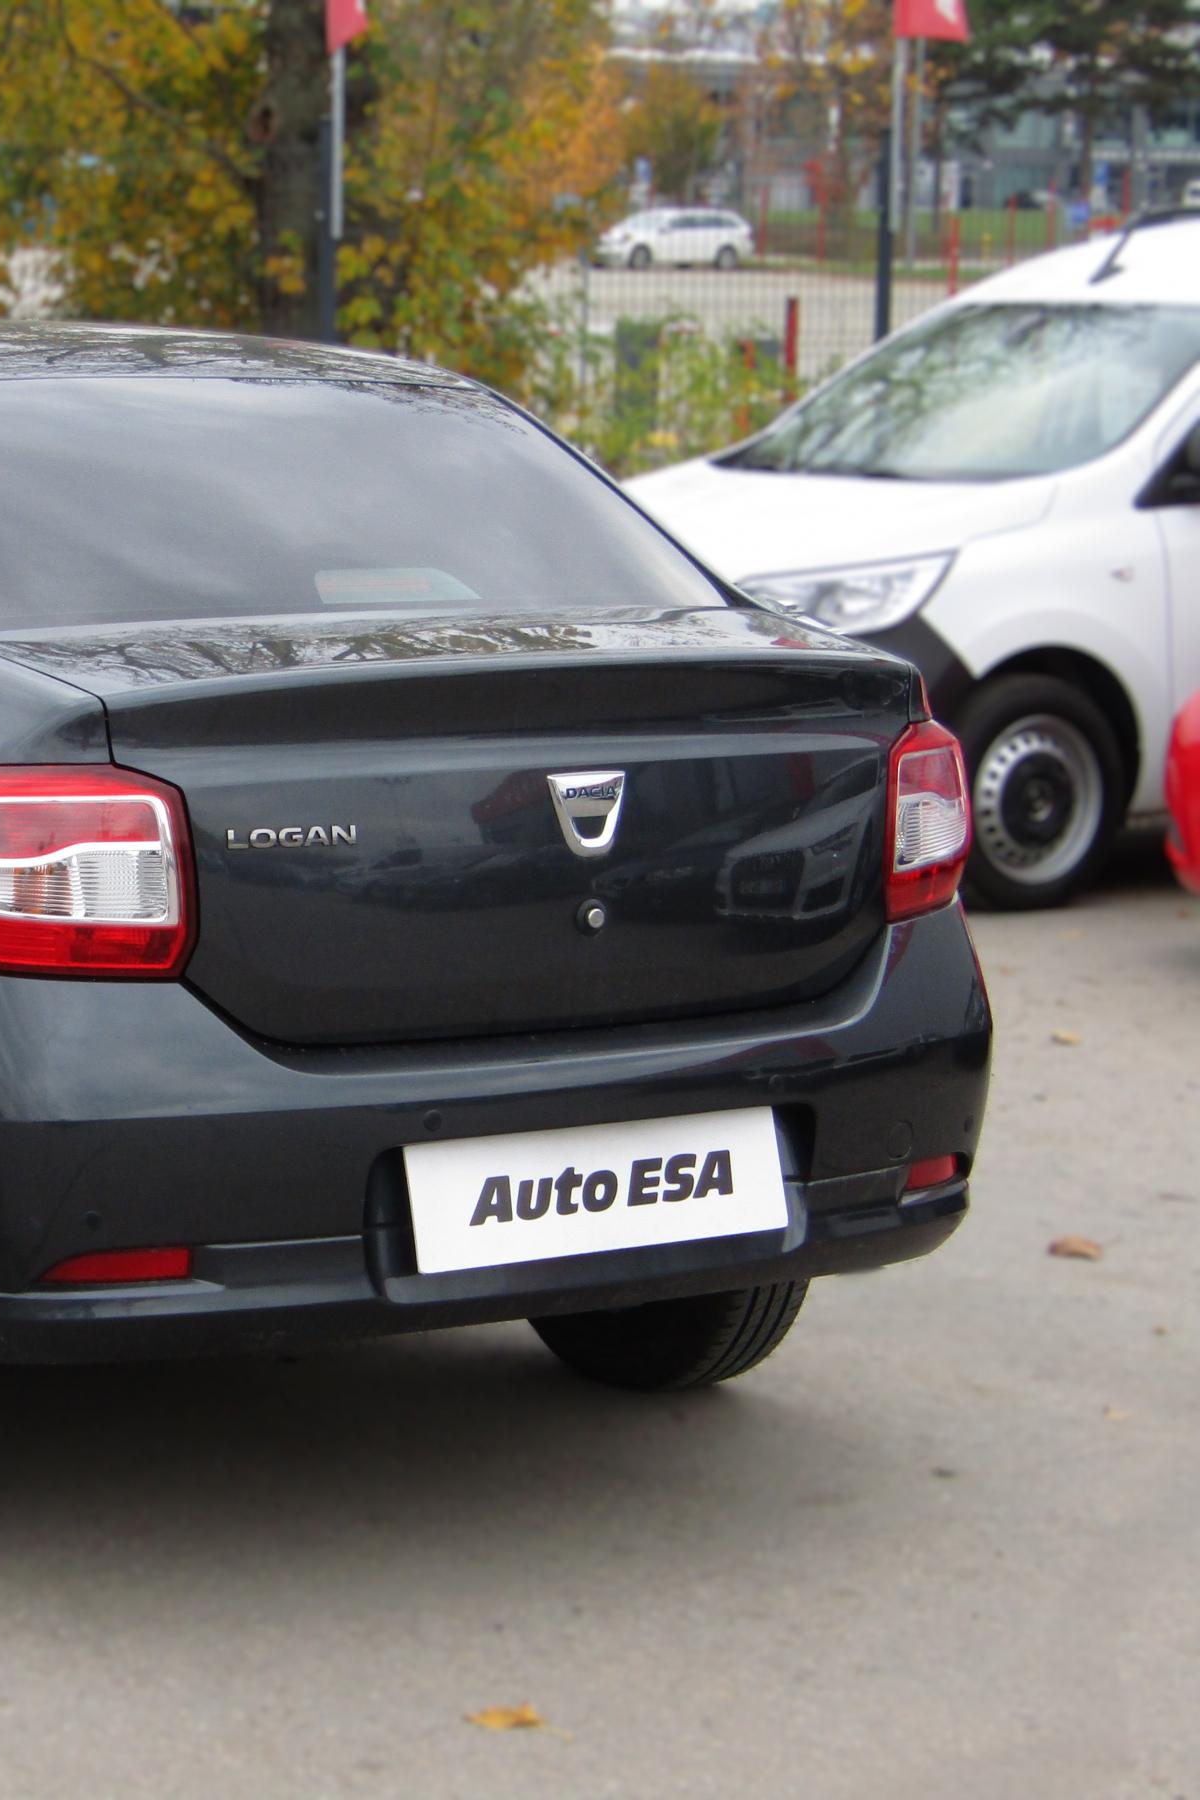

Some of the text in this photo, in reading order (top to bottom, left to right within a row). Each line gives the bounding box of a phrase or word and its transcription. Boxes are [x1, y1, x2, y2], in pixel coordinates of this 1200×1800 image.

[565, 786, 617, 800] DACIA
[227, 824, 358, 850] LOGAN
[468, 1149, 734, 1227] Auto ESA
